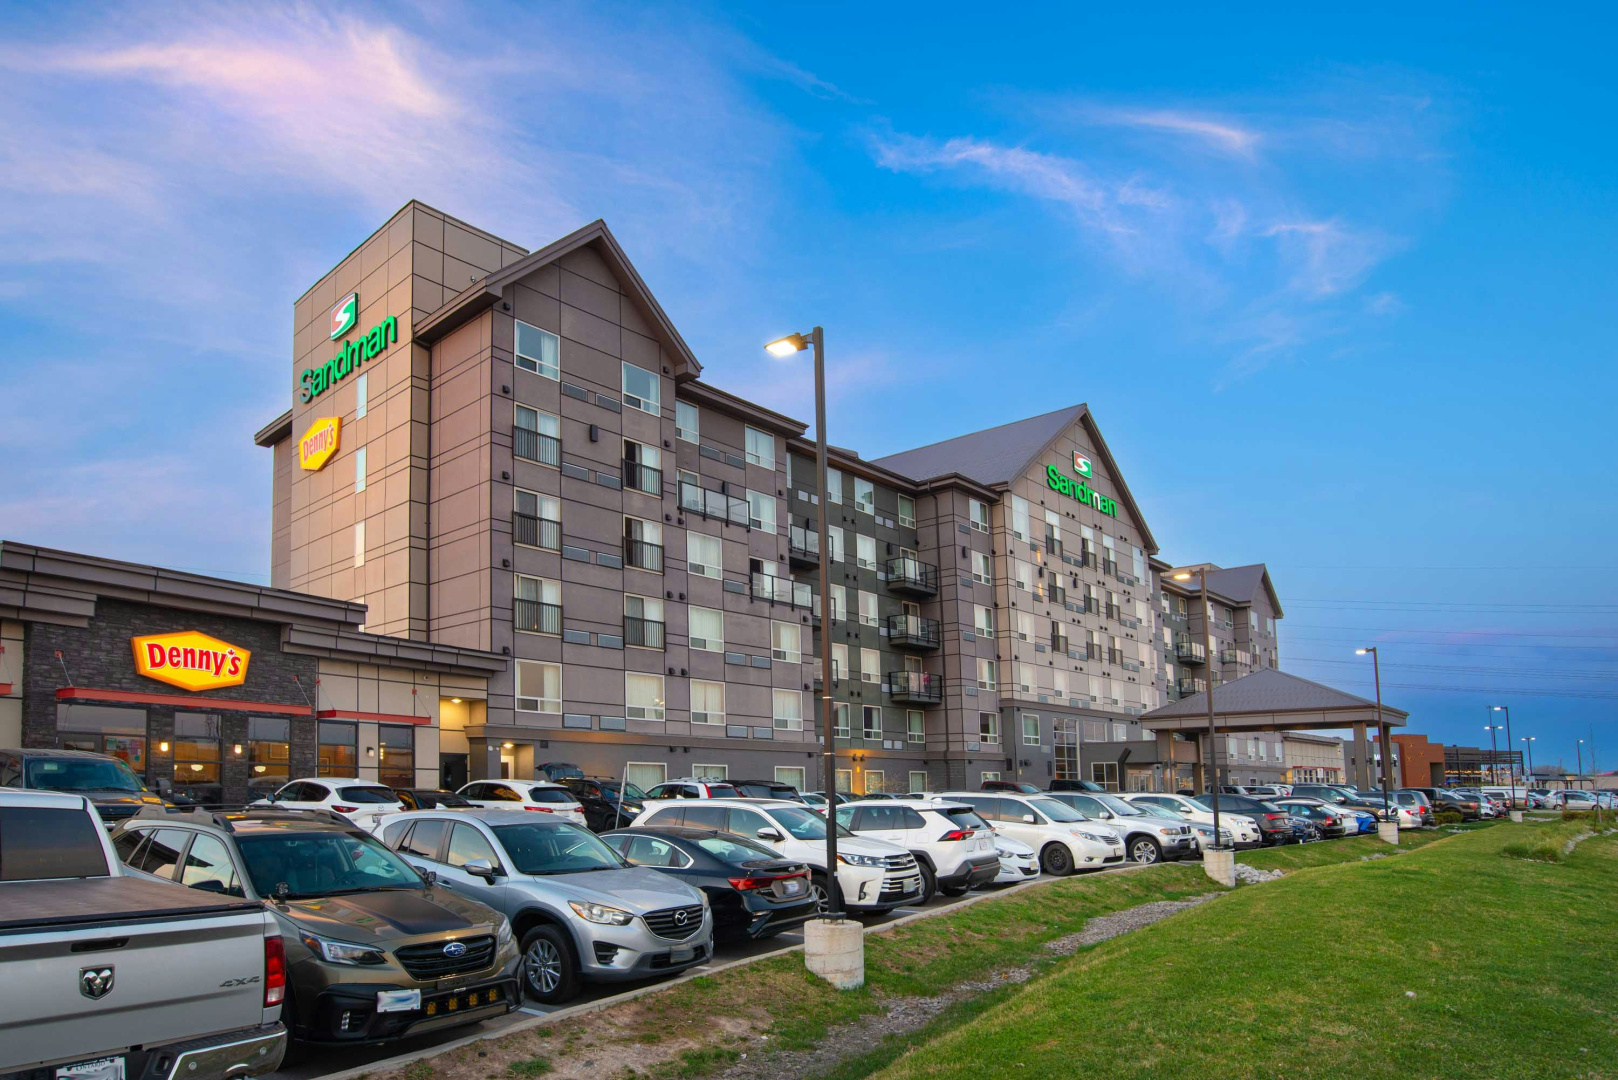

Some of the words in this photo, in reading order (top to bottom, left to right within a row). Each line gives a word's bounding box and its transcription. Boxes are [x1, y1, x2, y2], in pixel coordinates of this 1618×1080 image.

[300, 315, 398, 403] Sandman
[303, 424, 334, 462] Denny's
[1047, 464, 1117, 518] Sandman
[145, 642, 242, 677] Denny's
